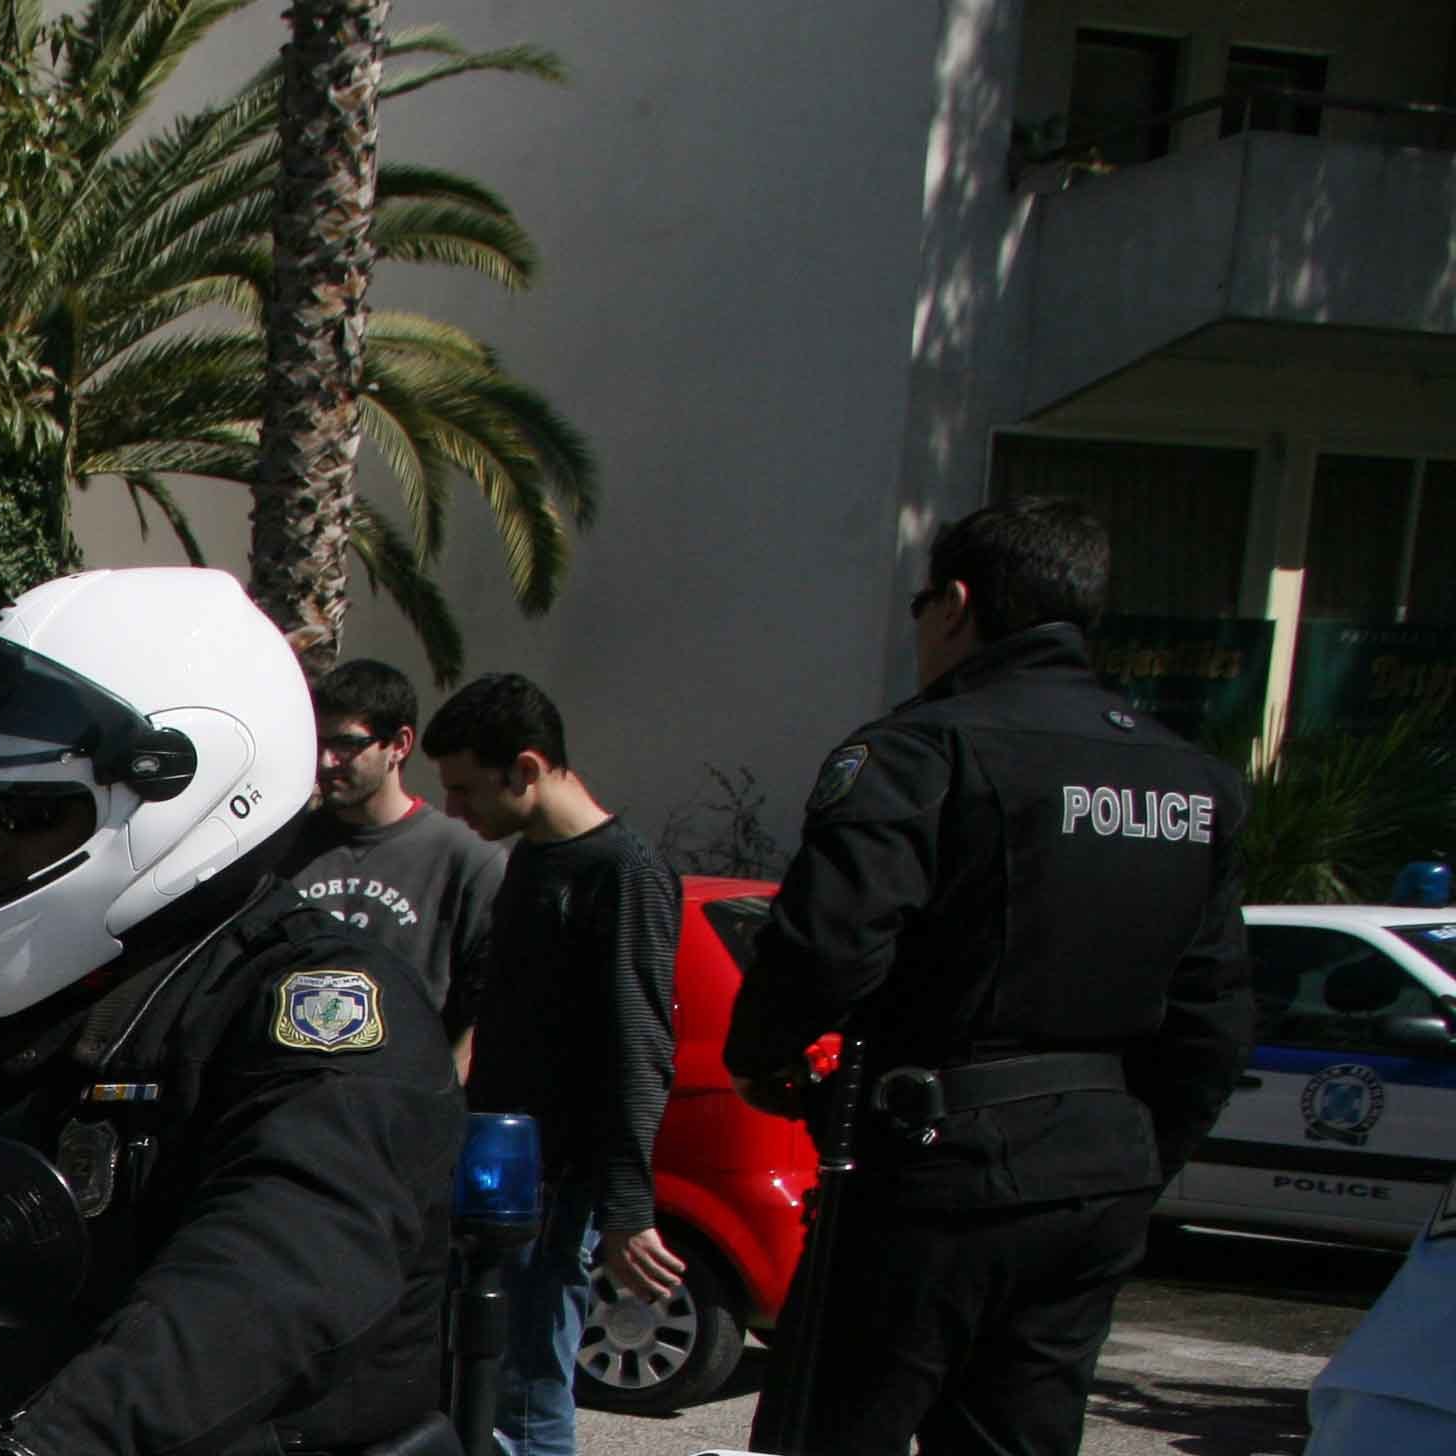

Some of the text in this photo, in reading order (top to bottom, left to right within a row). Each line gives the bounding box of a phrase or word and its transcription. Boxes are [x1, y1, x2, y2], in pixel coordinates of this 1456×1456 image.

[1061, 785, 1214, 844] POLICE
[363, 879, 417, 926] DEPT
[1273, 1175, 1391, 1198] POLICE
